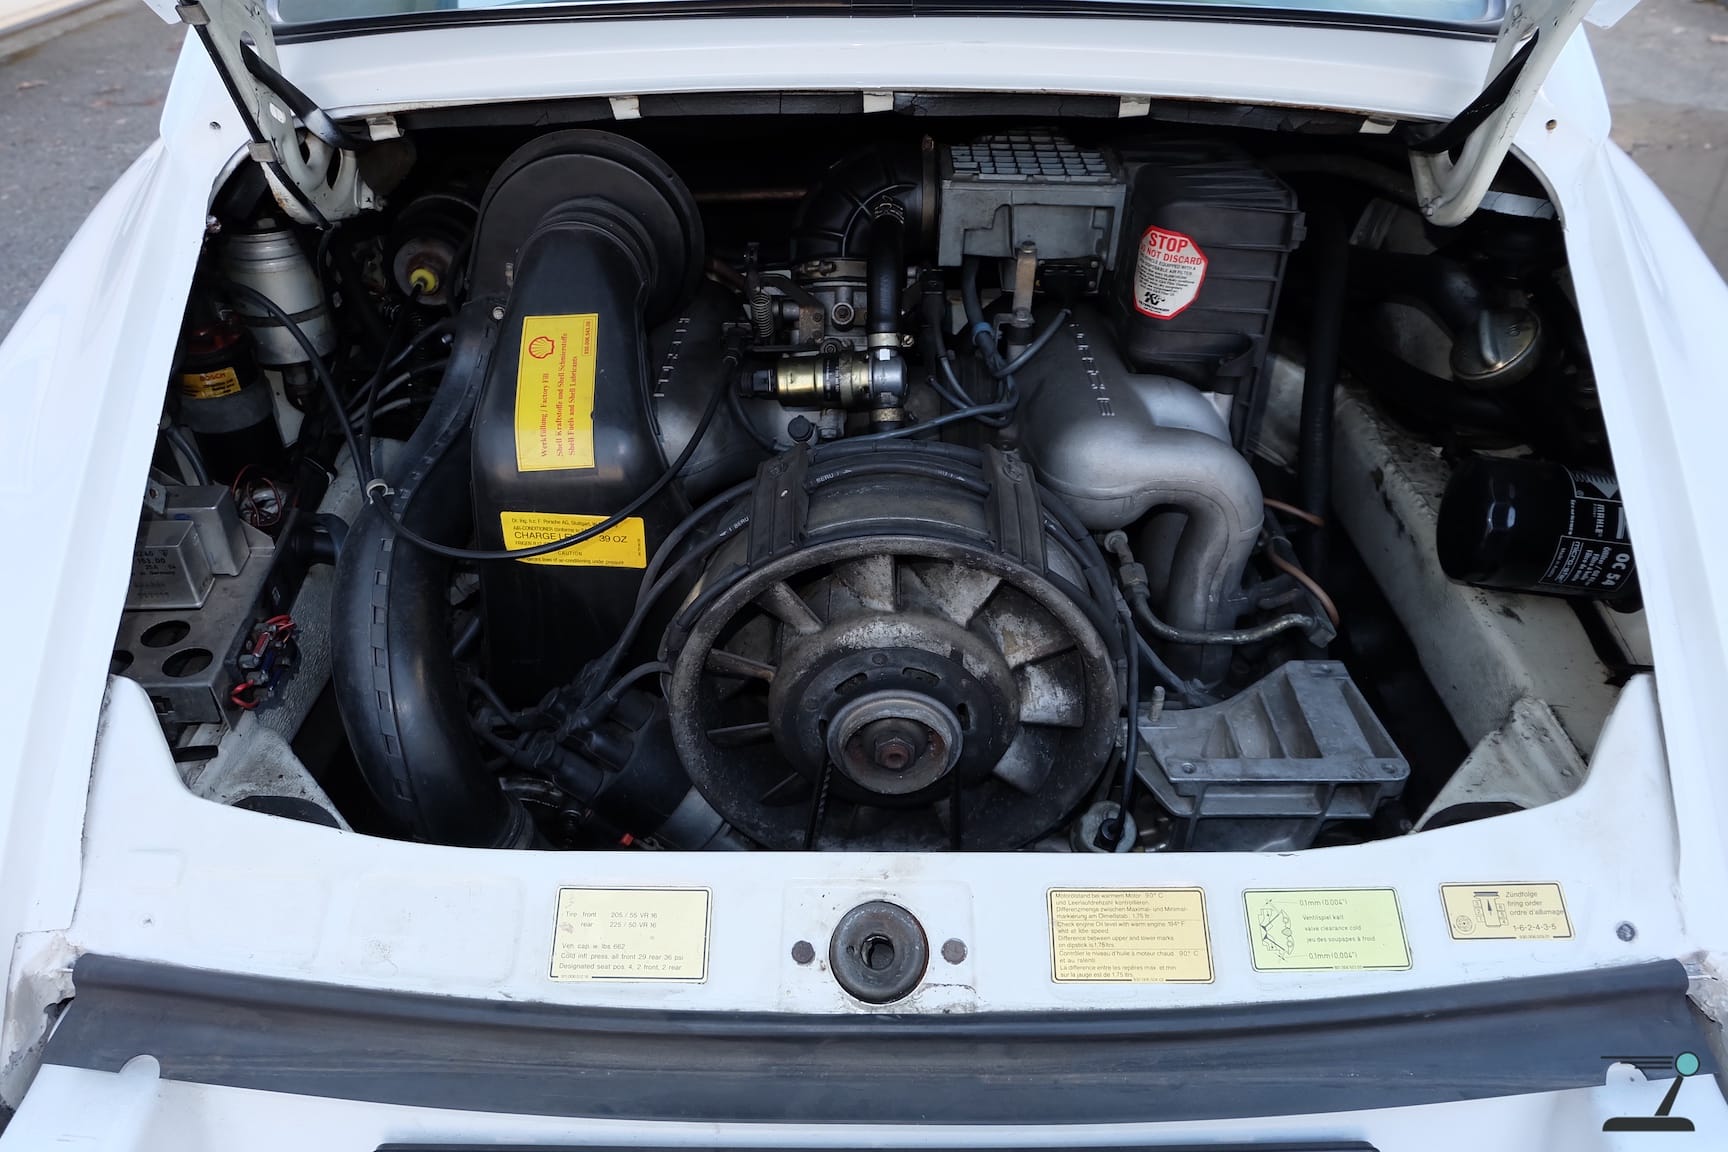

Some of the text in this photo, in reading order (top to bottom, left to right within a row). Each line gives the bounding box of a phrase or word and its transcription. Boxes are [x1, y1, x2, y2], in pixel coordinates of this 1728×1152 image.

[1149, 232, 1188, 253] STOP
[1147, 247, 1161, 259] NOT
[1163, 253, 1202, 266] DISCARD
[569, 356, 577, 386] Lubricants
[540, 385, 549, 408] Factory
[568, 388, 576, 403] Shell
[567, 417, 575, 435] Fuels
[555, 438, 563, 456] Shell
[733, 516, 750, 529] BERU
[514, 531, 556, 540] CHARGE
[599, 535, 628, 543] 39 OZ
[1601, 552, 1630, 586] OC 54
[611, 911, 623, 919] 205
[558, 962, 594, 970] Designated
